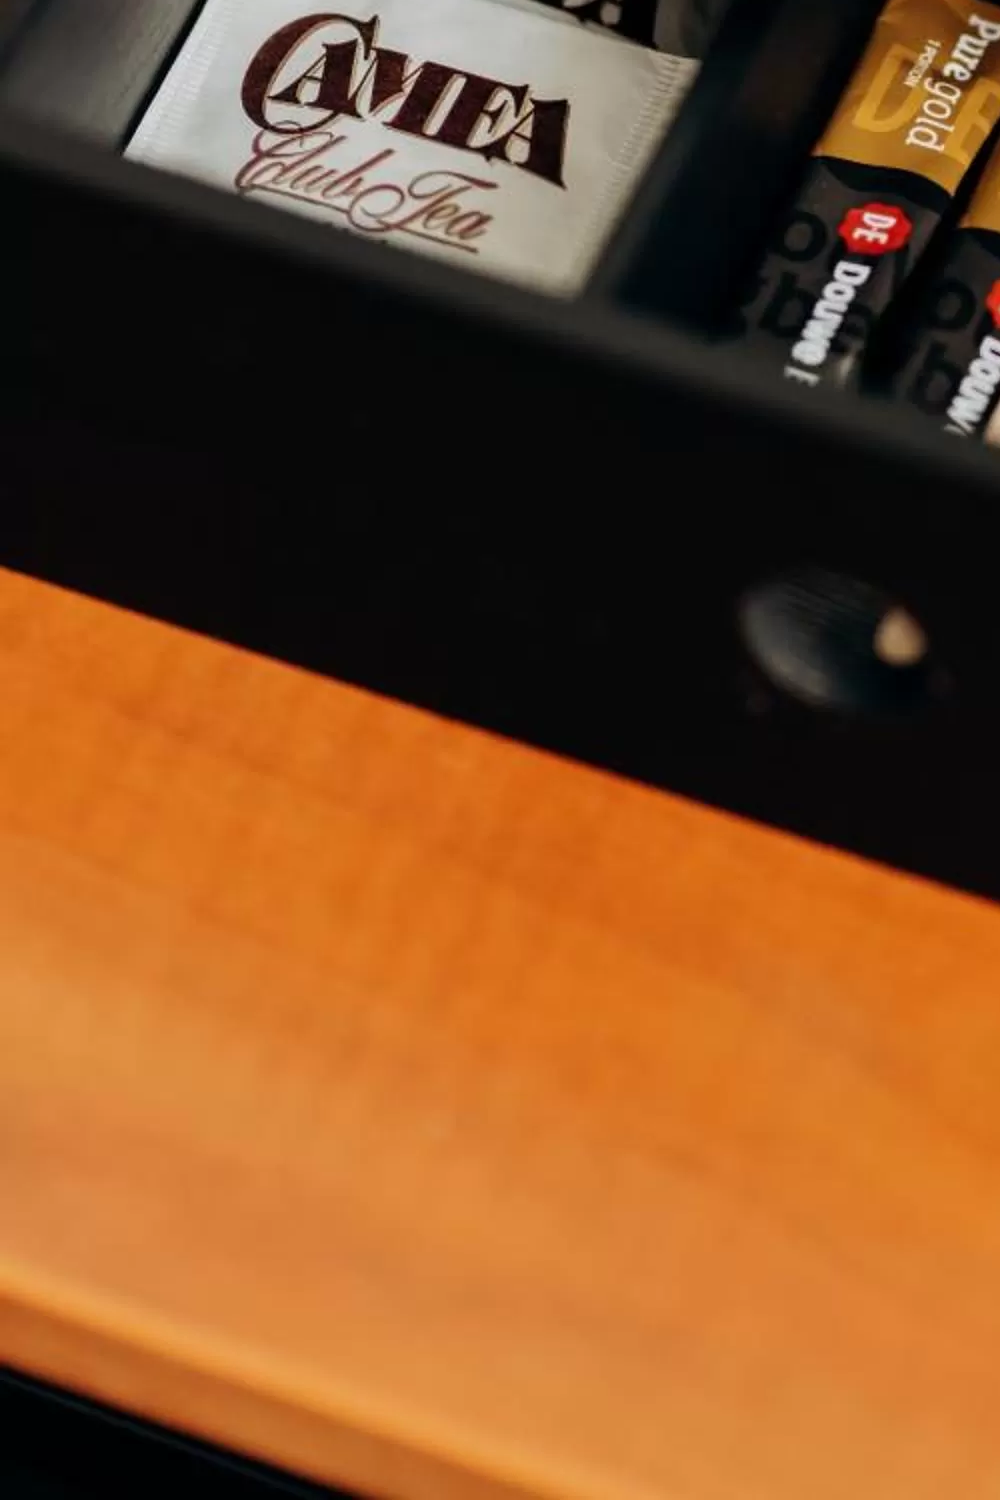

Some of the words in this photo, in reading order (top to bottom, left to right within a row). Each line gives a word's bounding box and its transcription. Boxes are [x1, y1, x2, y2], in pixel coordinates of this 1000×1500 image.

[241, 12, 569, 191] CAMEA
[903, 45, 940, 87] PORTION
[905, 76, 962, 152] gold
[234, 120, 396, 197] Club
[350, 169, 500, 236] Tea
